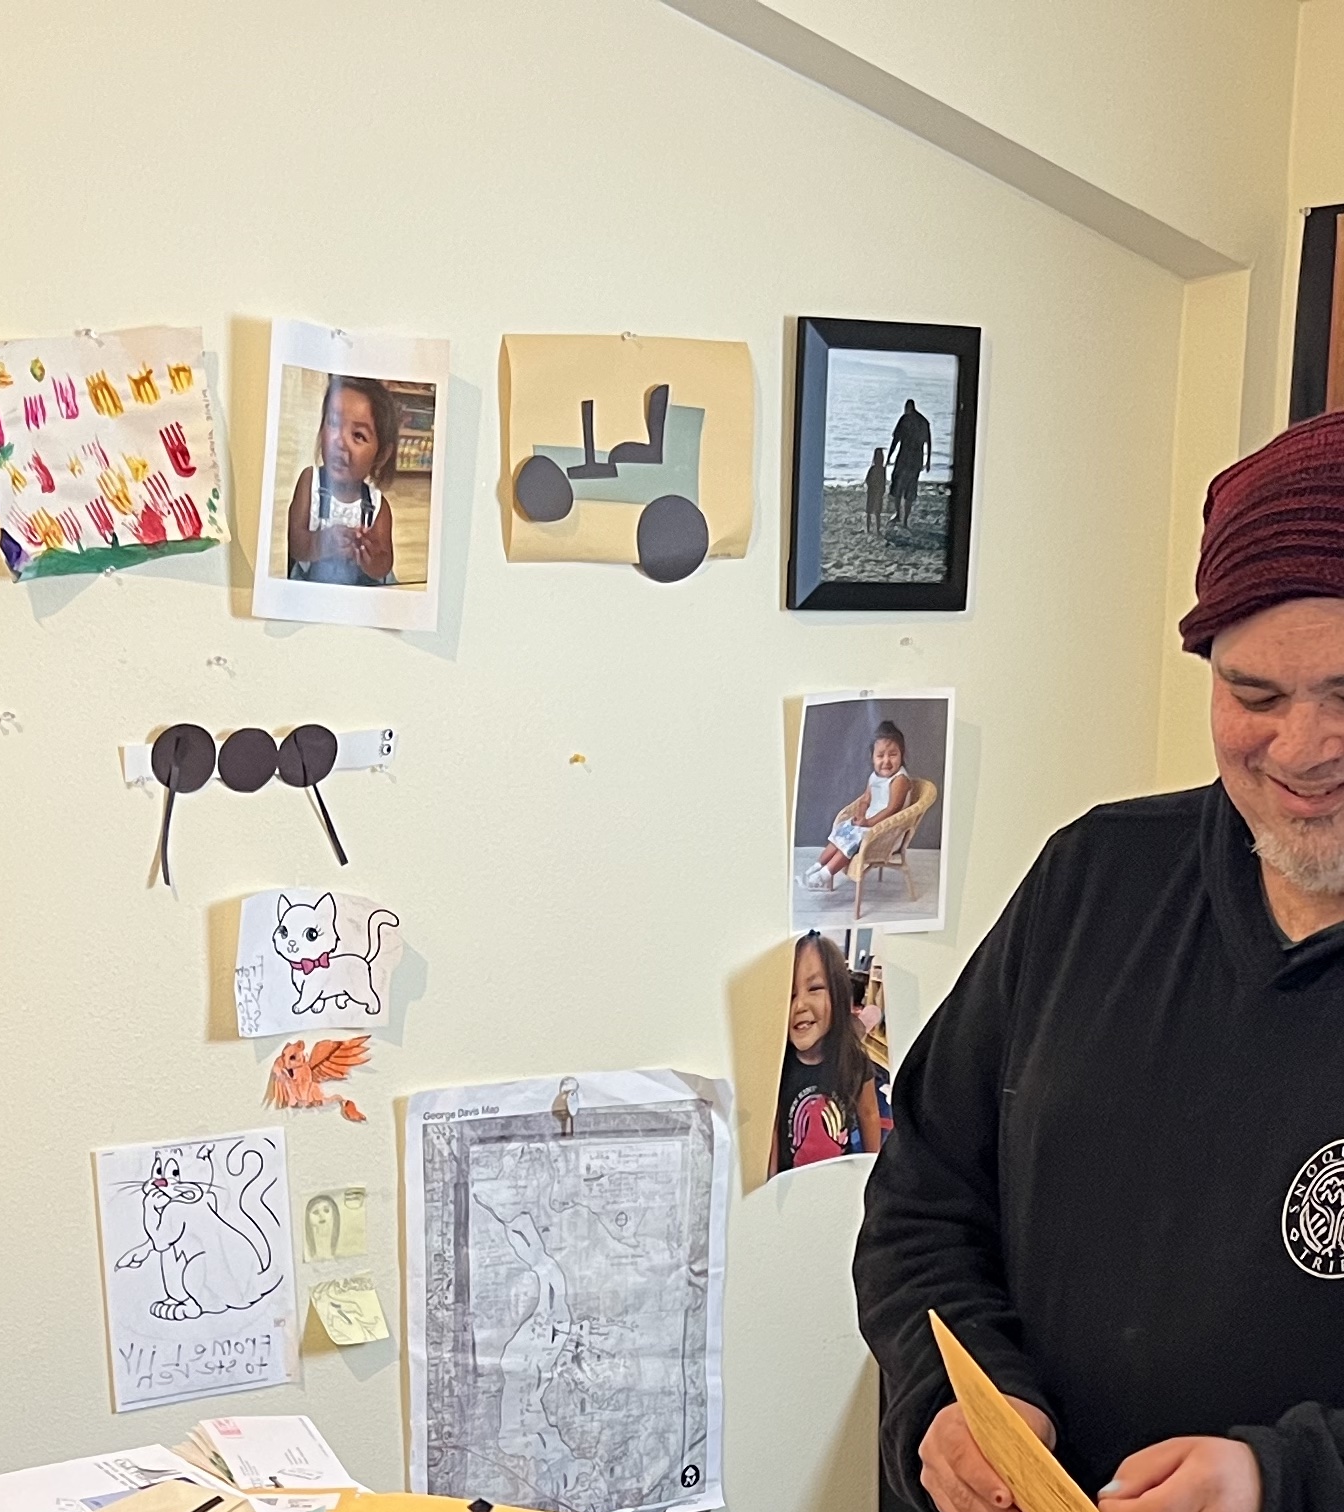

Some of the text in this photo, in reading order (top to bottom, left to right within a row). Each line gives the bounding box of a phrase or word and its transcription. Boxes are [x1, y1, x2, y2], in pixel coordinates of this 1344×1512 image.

[422, 1104, 501, 1124] George Davis Map
